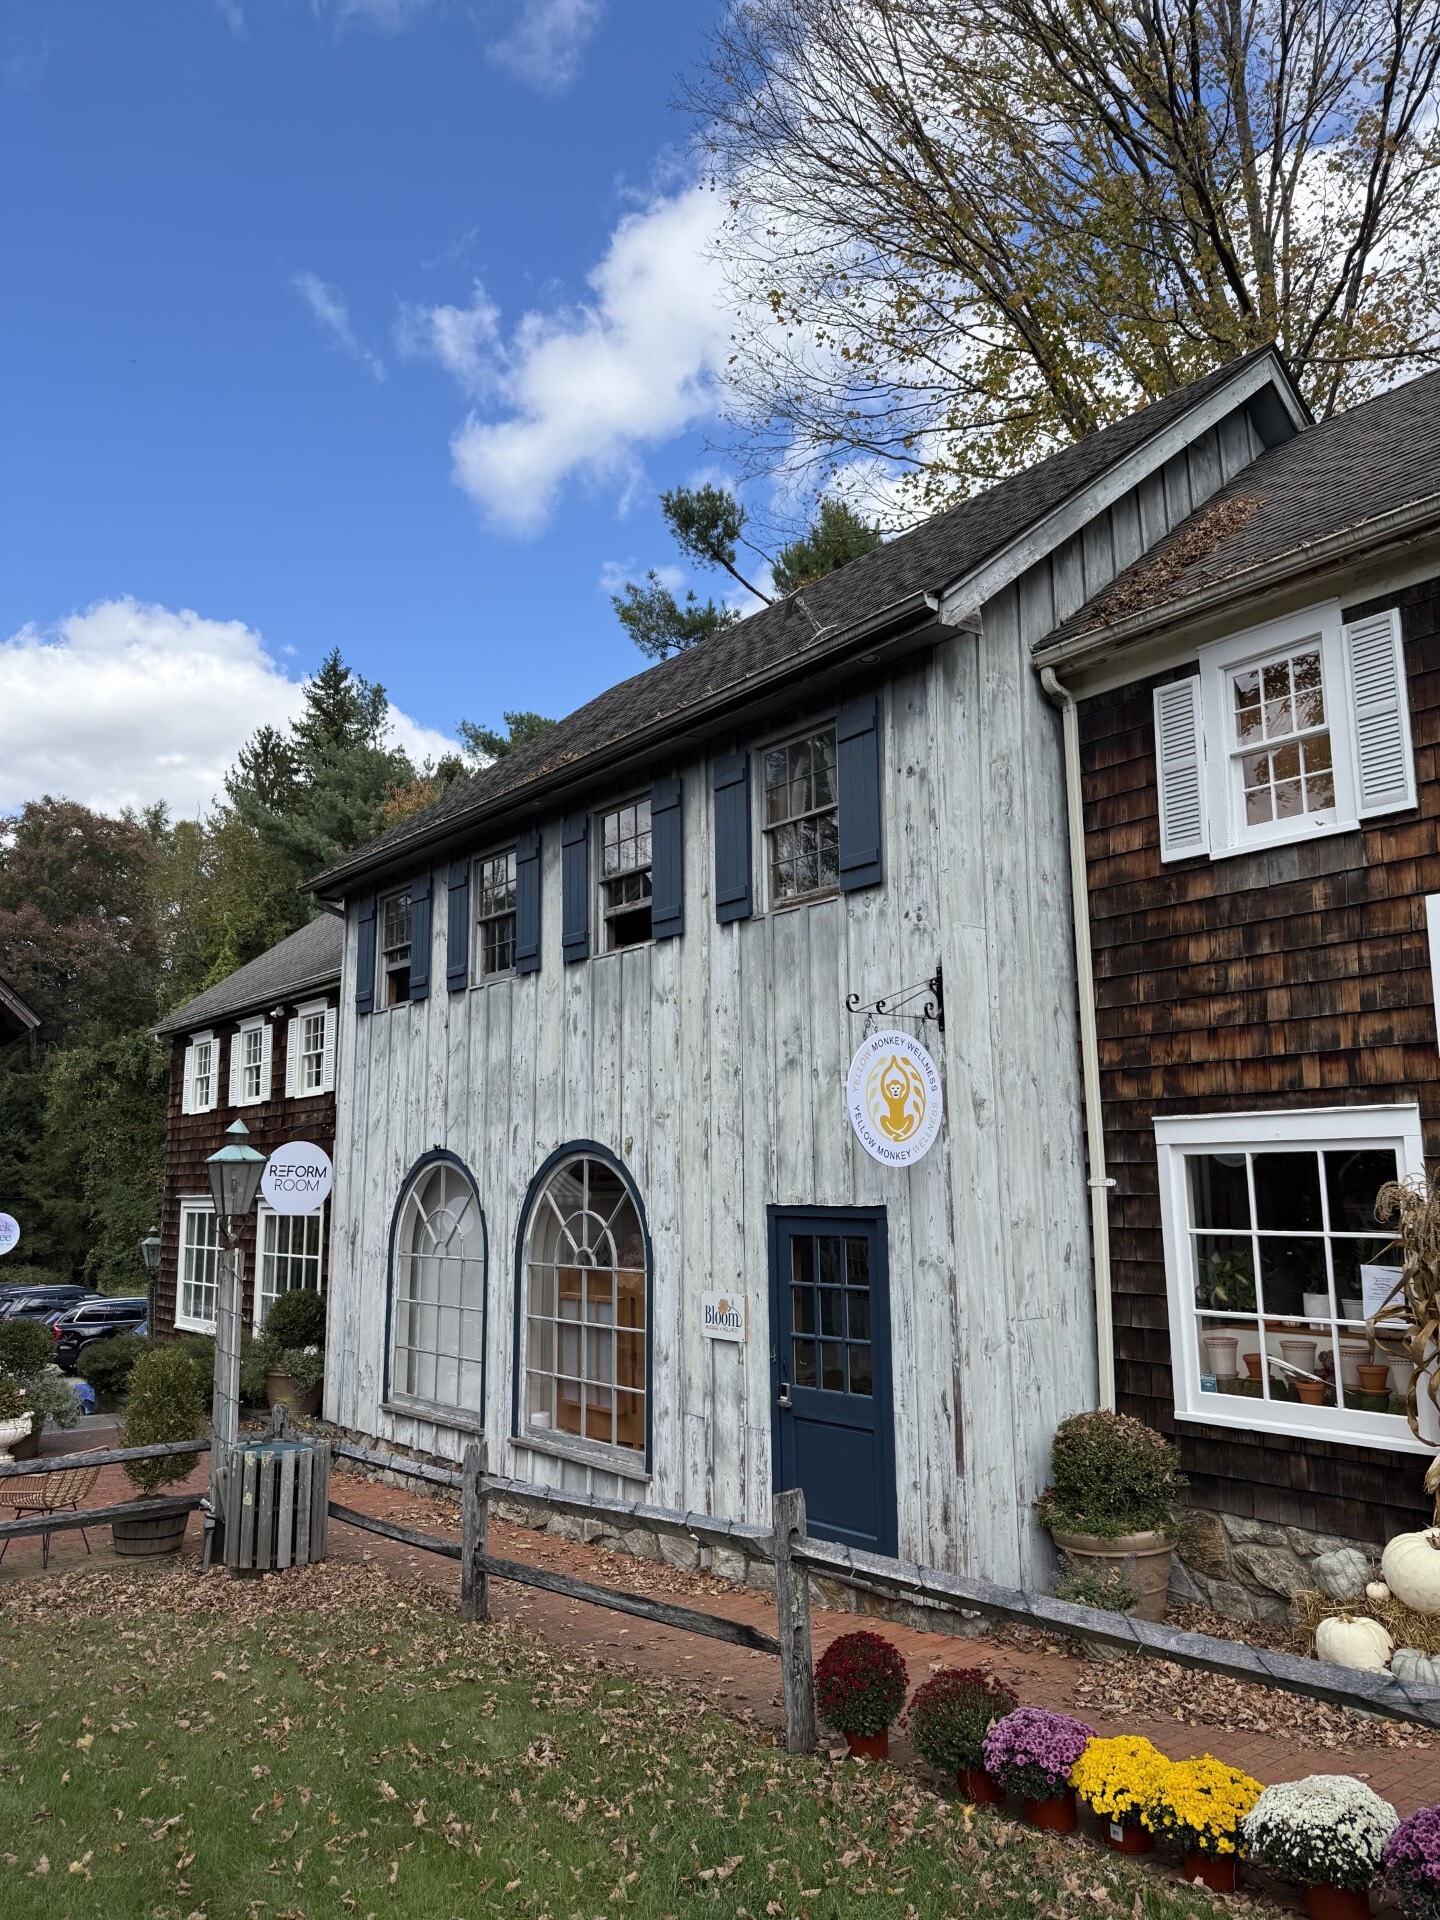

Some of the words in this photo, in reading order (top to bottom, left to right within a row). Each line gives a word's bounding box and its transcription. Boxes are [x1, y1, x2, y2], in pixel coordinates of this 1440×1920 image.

[852, 1048, 873, 1093] YELLOW
[871, 1036, 906, 1052] MONKEY
[907, 1041, 938, 1092] WELLNESS
[854, 1104, 877, 1148] YELLOW
[876, 1145, 911, 1160] MONKEY
[912, 1102, 939, 1153] WELLNESS
[269, 1164, 327, 1178] REFORM
[274, 1178, 320, 1191] ROOM
[705, 1304, 742, 1328] Bloom
